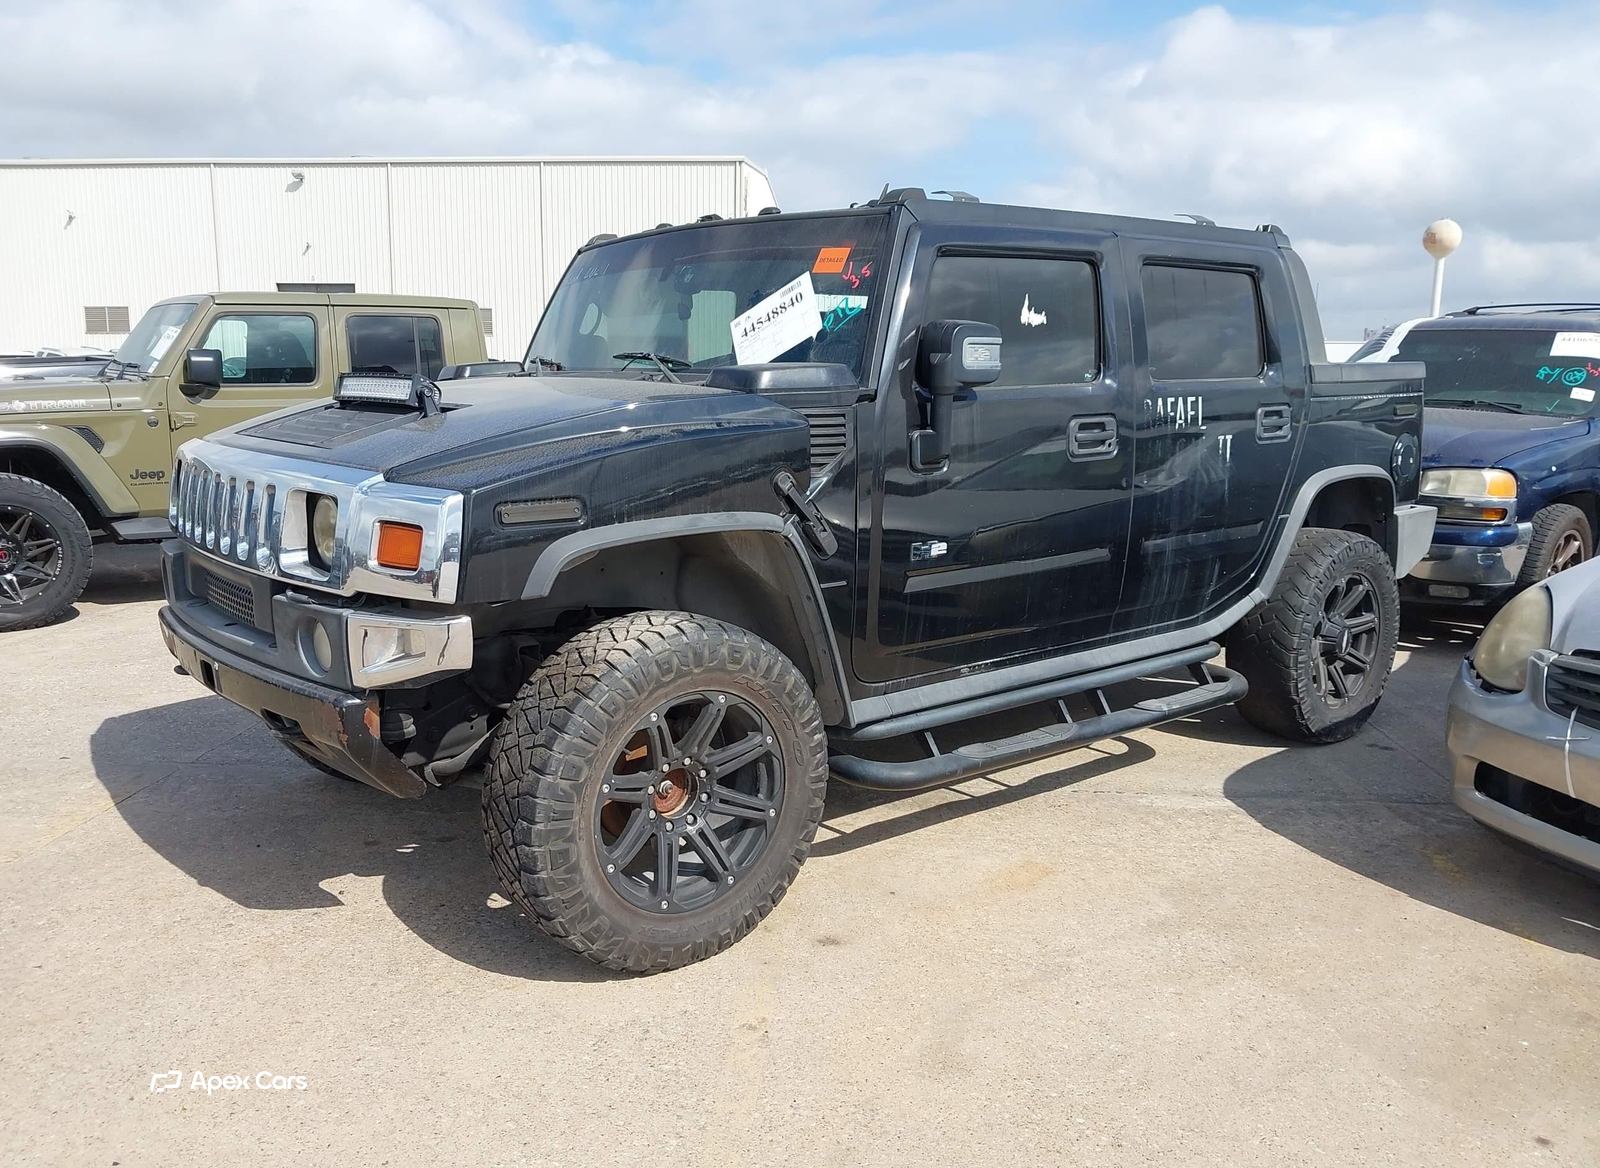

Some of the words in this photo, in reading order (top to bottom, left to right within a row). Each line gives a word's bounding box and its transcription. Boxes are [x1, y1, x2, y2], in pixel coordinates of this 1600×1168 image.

[741, 291, 803, 338] 44548840
[29, 399, 94, 411] TRAIL
[129, 468, 166, 481] Jeep
[911, 540, 948, 561] H2
